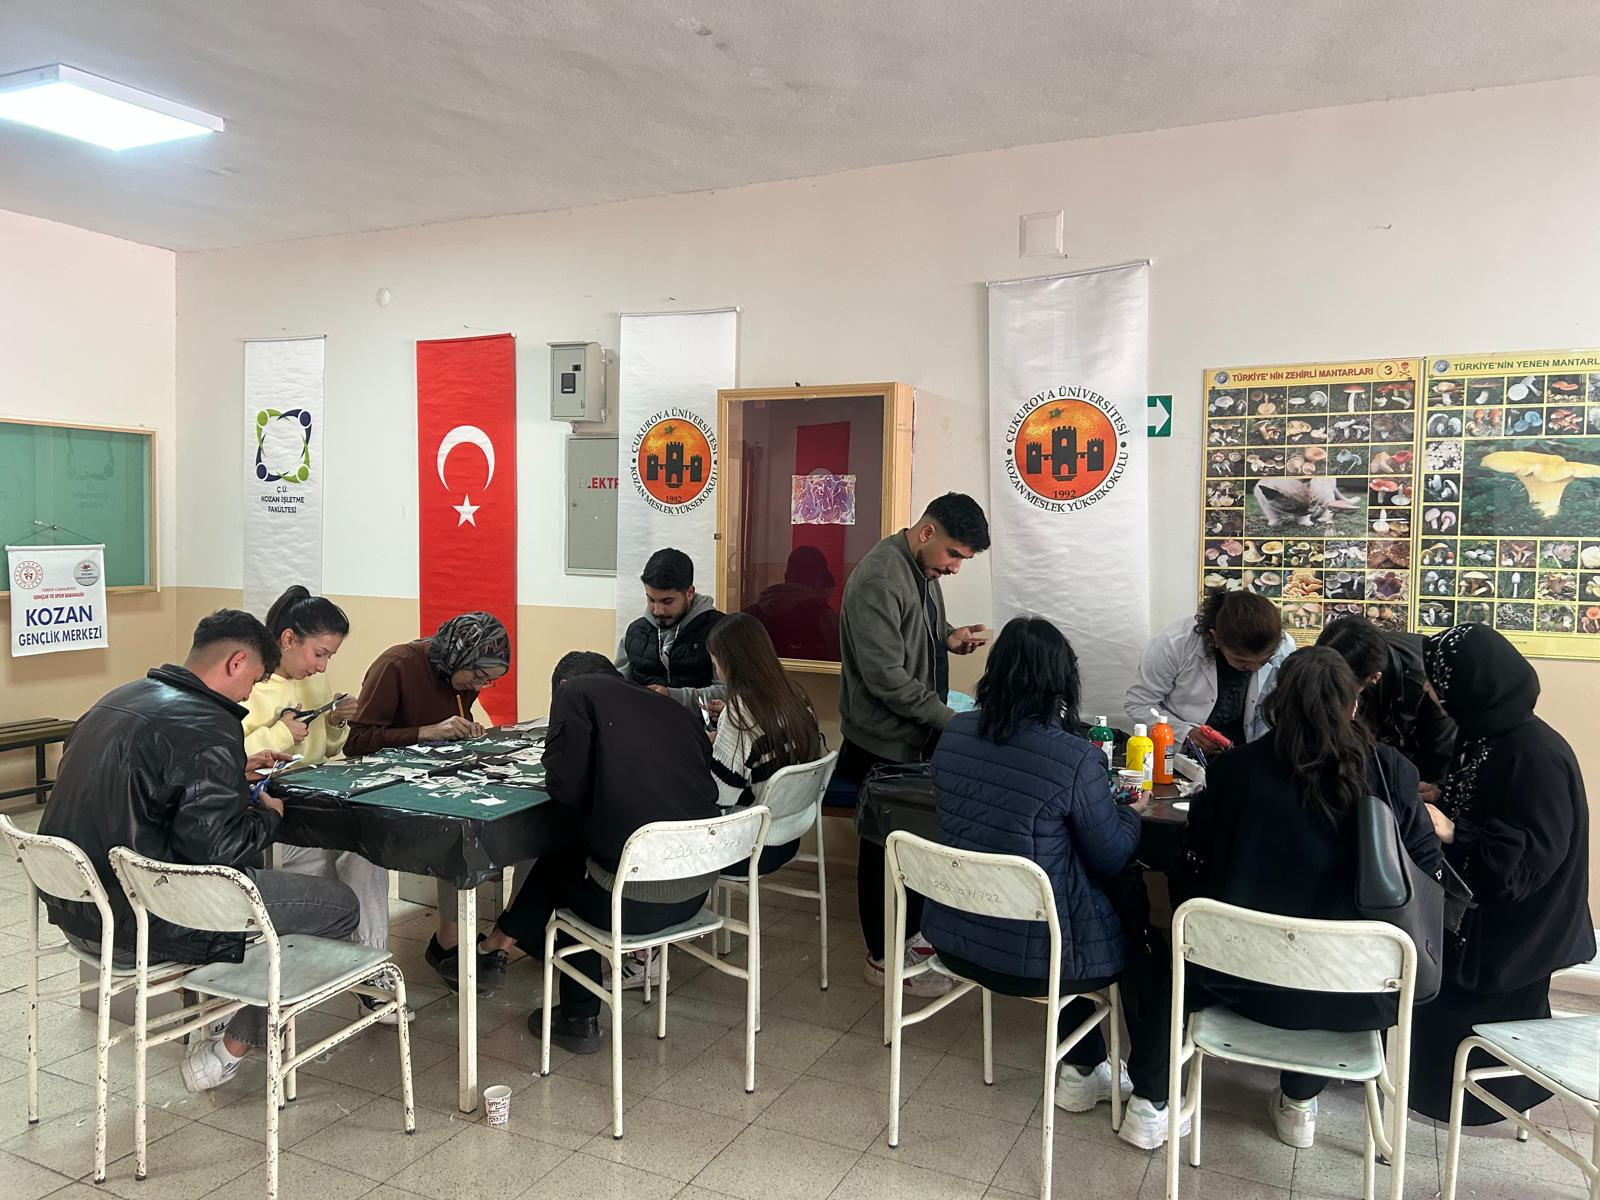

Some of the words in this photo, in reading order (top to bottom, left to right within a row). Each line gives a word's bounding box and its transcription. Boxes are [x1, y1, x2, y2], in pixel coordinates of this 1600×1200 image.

[1384, 365, 1393, 375] 3
[1517, 360, 1549, 368] YENEN
[1552, 358, 1600, 367] MANTARL
[1270, 370, 1284, 380] NİN
[1285, 368, 1317, 380] ZEHİRLİ
[1319, 368, 1373, 378] MANTARLARI
[1006, 389, 1056, 443] ÇUKUROVA
[1058, 385, 1131, 437] ÜNİVERSİTESİ
[631, 410, 670, 454] ÇUKUROVA
[1005, 459, 1027, 495] KOZAN
[1024, 491, 1065, 512] MESLEK
[1067, 452, 1129, 512] YÜKSEKOKULU
[630, 466, 647, 498] KOZAN
[644, 494, 674, 515] MESLEK
[1053, 490, 1076, 499] 1992
[261, 495, 280, 503] KOZAN
[281, 495, 305, 504] İŞLETME
[268, 505, 297, 513] FAKÜLTESİ
[25, 605, 93, 627] KOZAN
[18, 630, 60, 646] GENÇLİK
[62, 625, 102, 642] MERKEZİ
